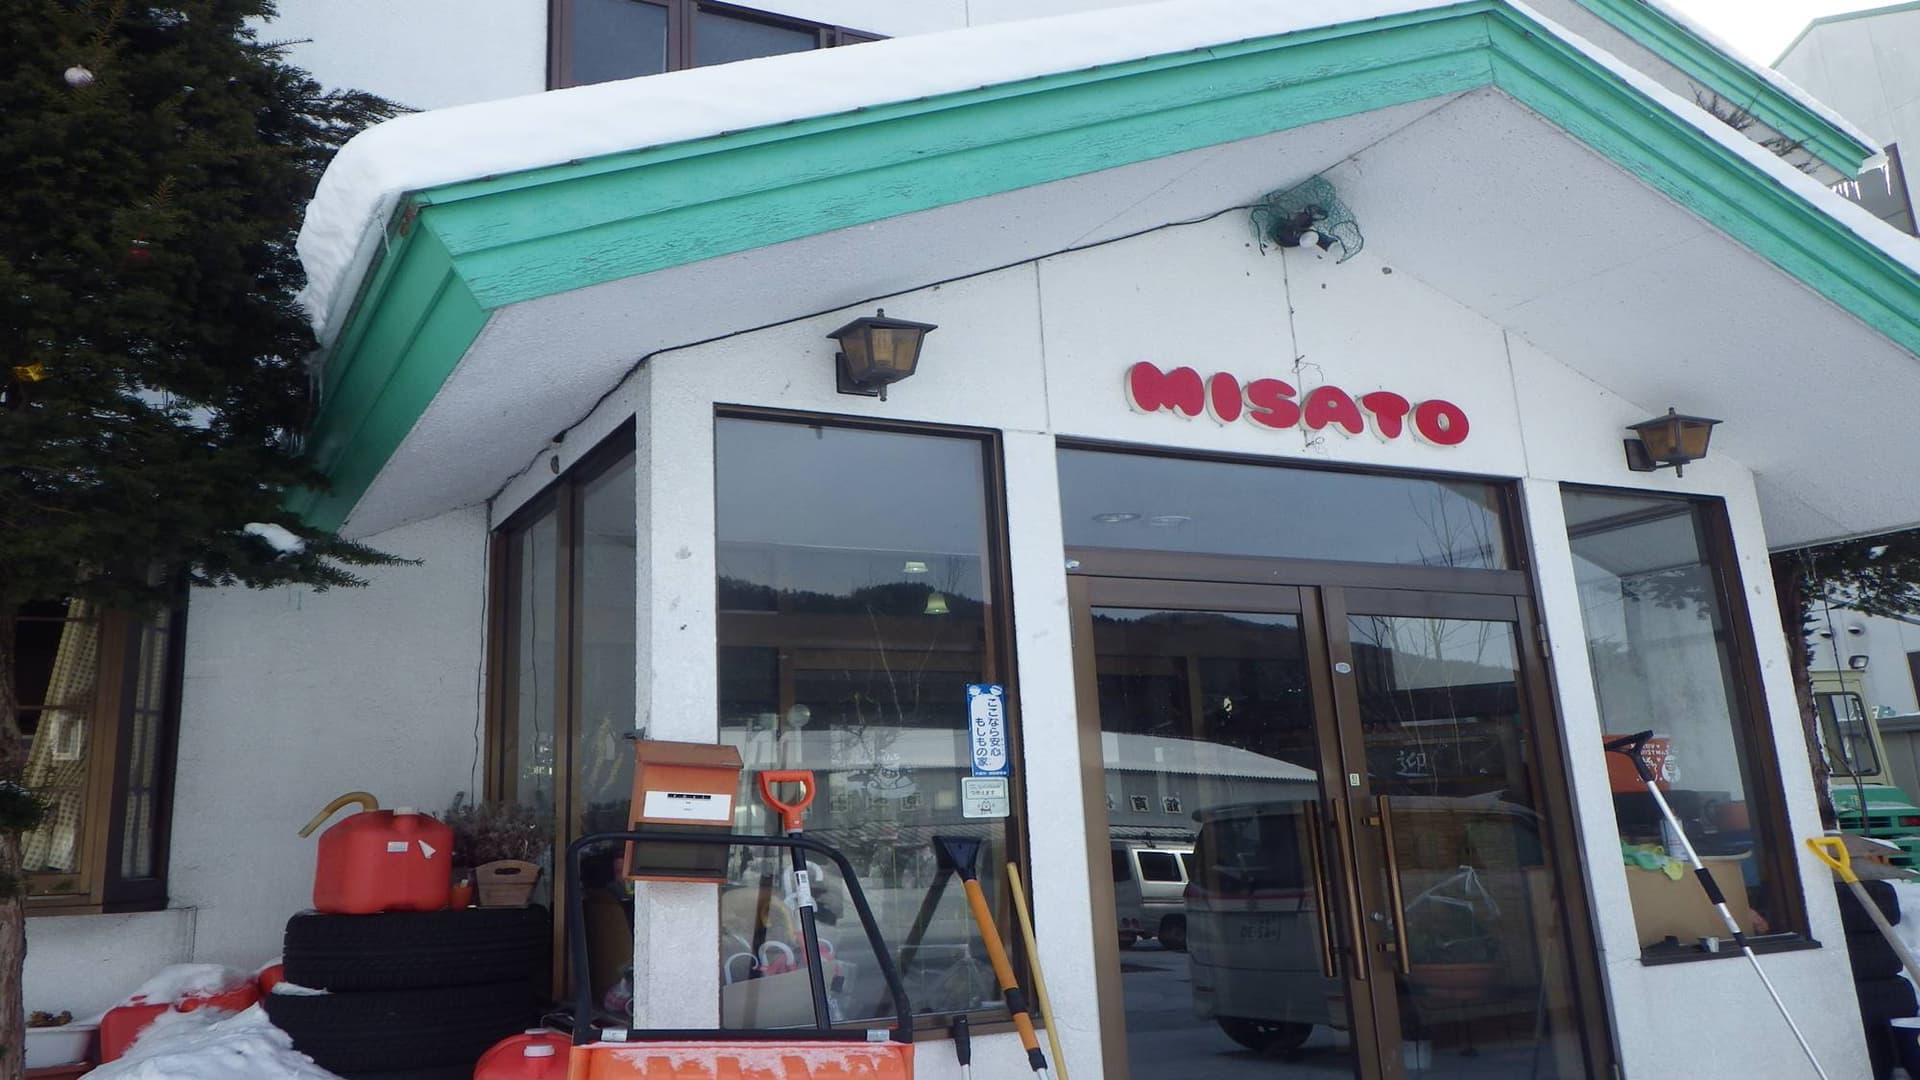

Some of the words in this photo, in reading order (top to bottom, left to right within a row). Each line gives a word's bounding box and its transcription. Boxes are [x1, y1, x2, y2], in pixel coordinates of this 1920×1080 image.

[1127, 361, 1470, 445] MISATO
[976, 718, 988, 766] もしもの家
[988, 698, 1000, 757] ここなら安心
